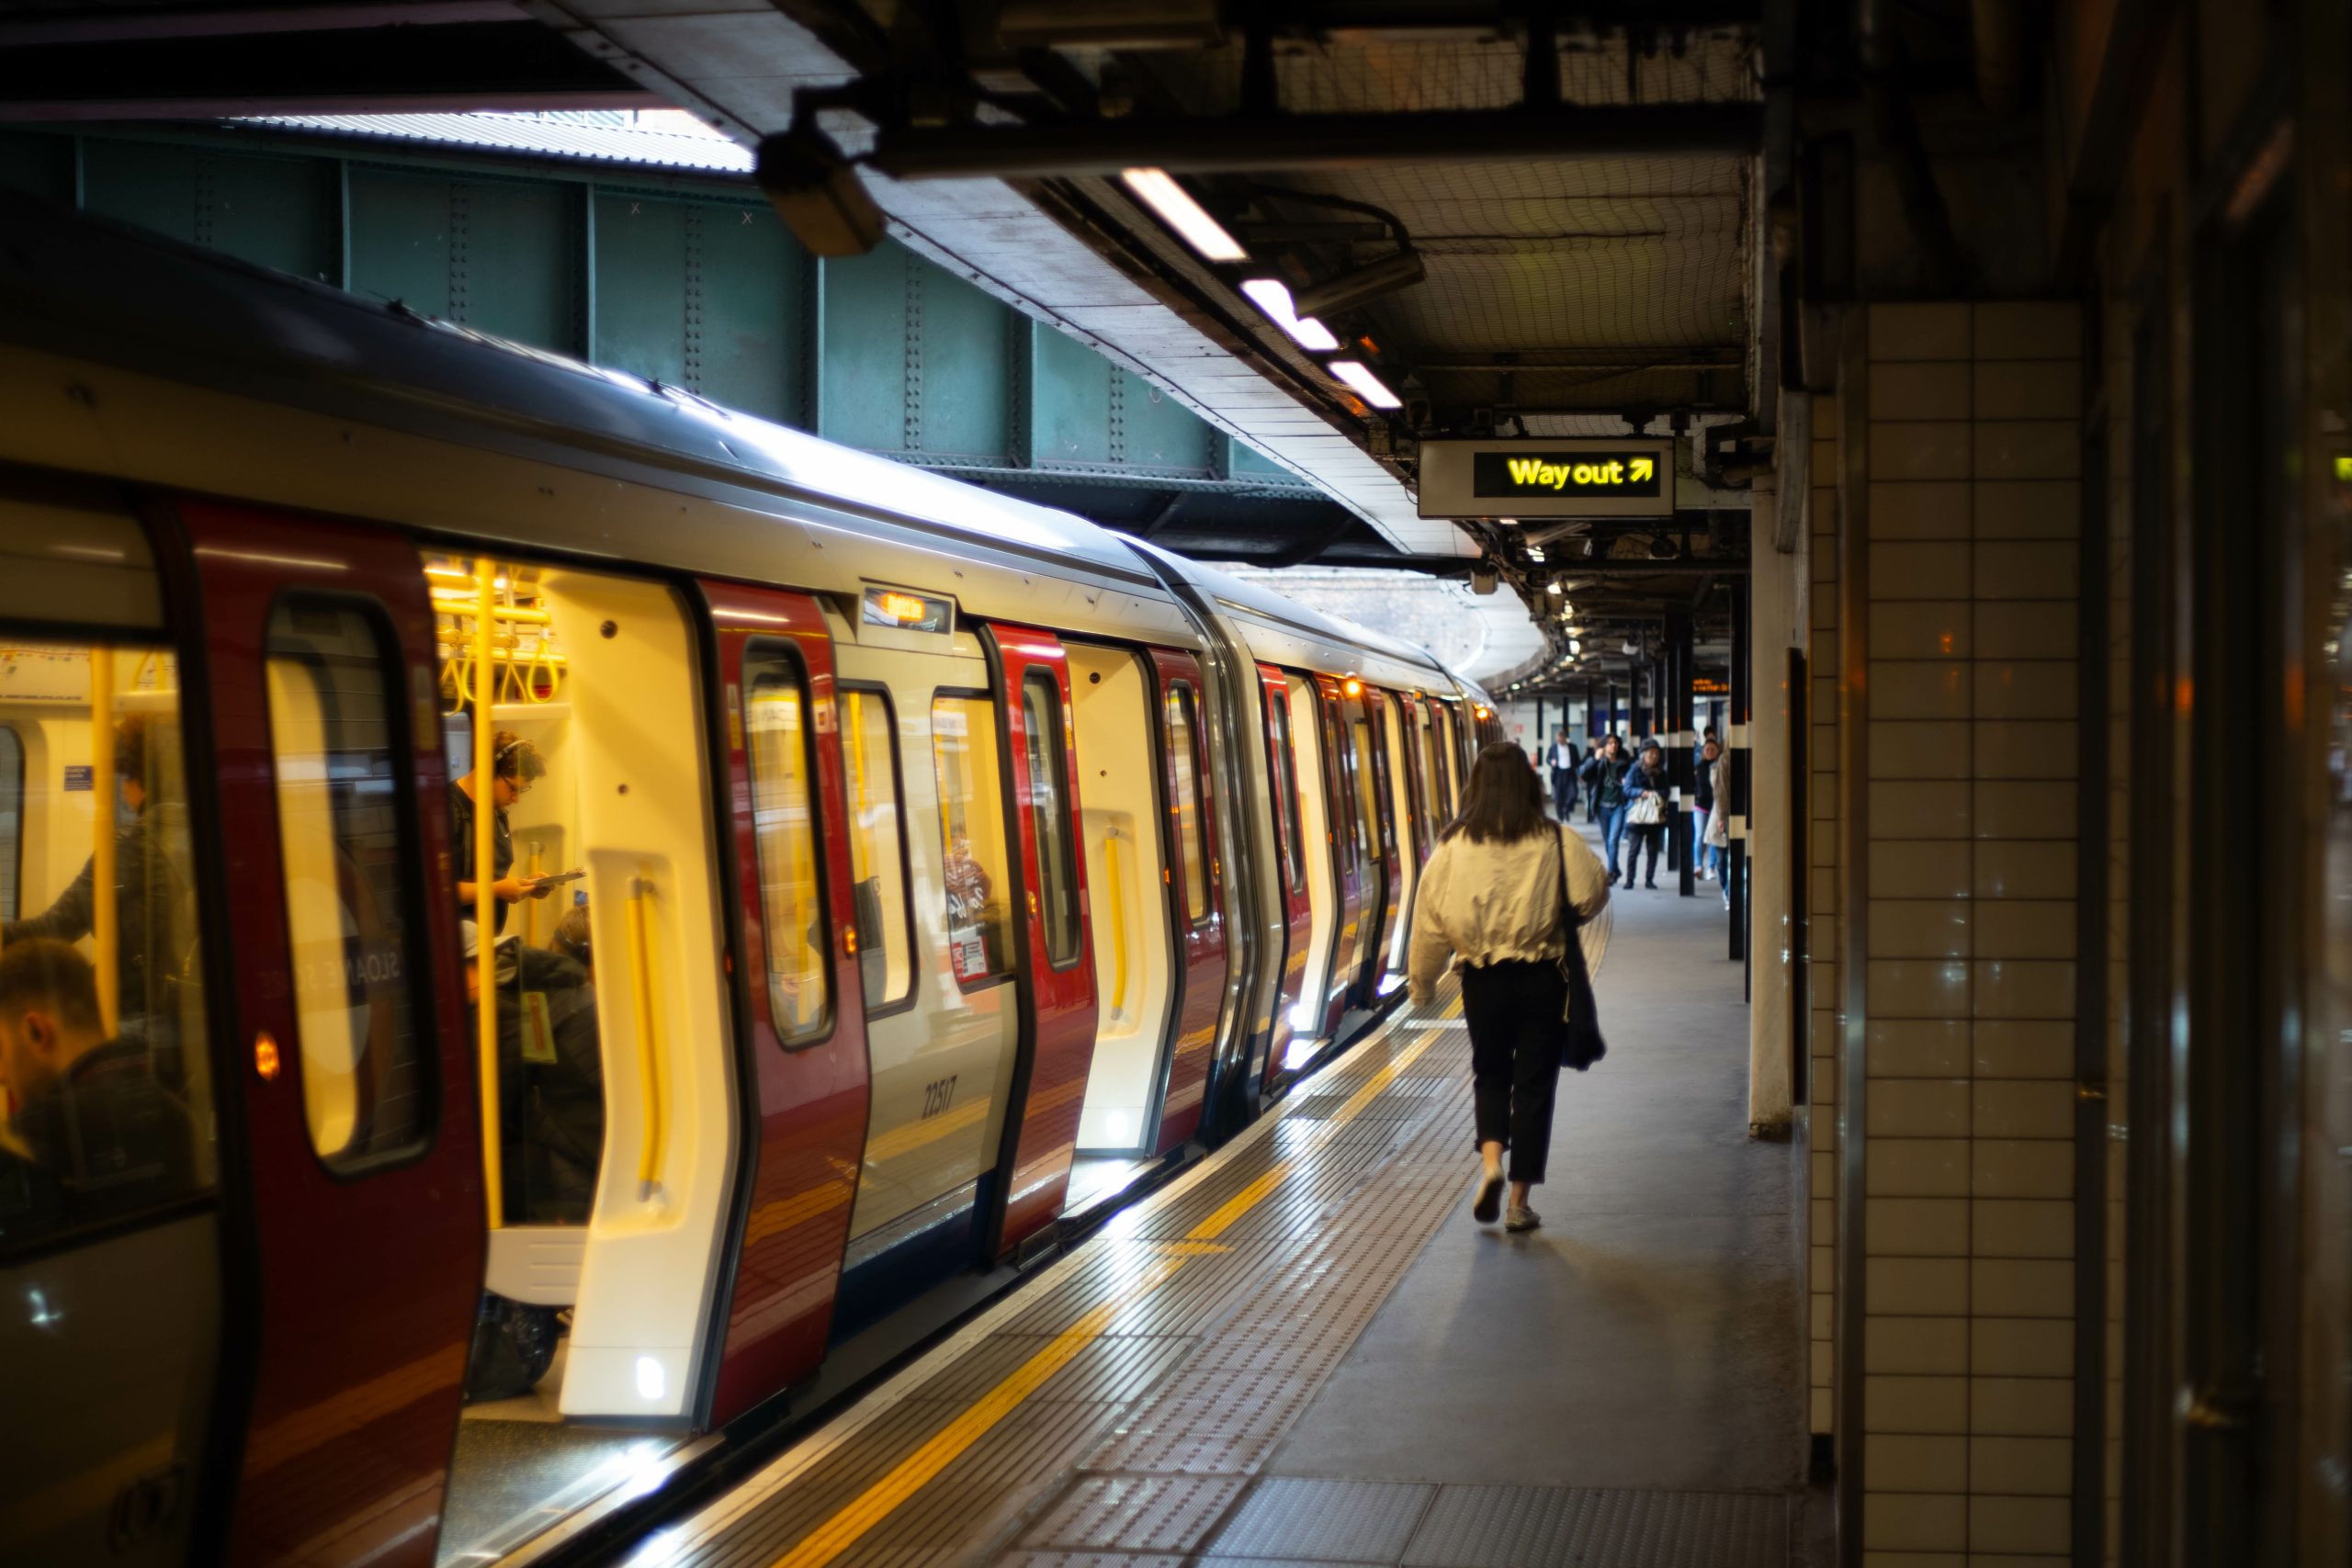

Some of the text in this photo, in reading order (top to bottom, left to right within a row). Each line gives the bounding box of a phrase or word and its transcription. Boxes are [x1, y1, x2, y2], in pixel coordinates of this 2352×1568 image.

[1508, 458, 1623, 490] Way out
[921, 1074, 958, 1121] 22517
